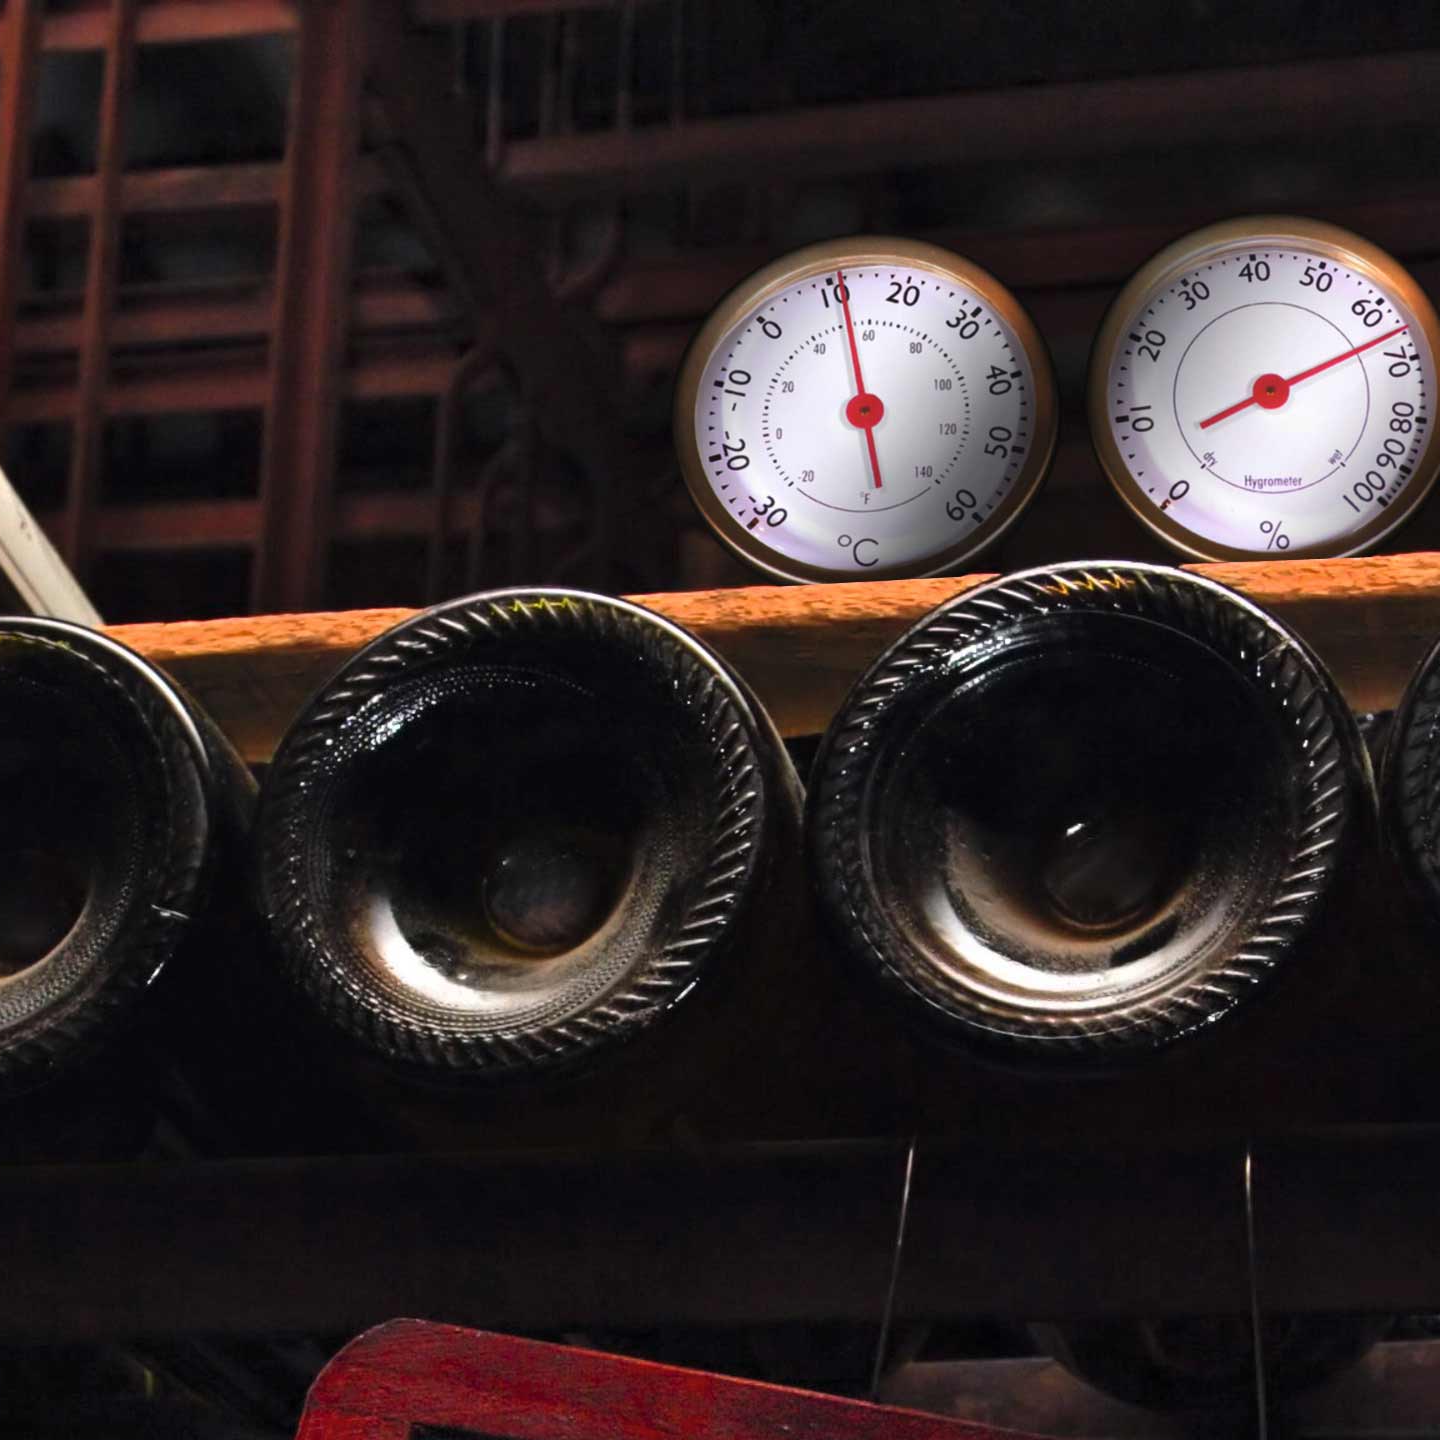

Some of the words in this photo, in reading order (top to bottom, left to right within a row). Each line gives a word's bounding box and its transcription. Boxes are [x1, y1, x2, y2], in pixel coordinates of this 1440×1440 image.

[1239, 261, 1270, 281] 40
[1299, 266, 1333, 292] 50
[821, 283, 850, 308] 10
[886, 282, 920, 306] 20
[1177, 280, 1210, 311] 30
[946, 309, 980, 340] 30
[1351, 299, 1383, 328] 60
[762, 321, 782, 339] 0
[862, 329, 875, 342] 60
[813, 343, 826, 355] 40
[909, 342, 922, 355] 80
[1138, 329, 1166, 361] 20
[1383, 346, 1410, 377] 70
[724, 369, 751, 412] -10
[781, 381, 794, 393] 20
[934, 379, 952, 391] 100
[986, 364, 1012, 395] 40
[939, 423, 957, 435] 120
[1130, 405, 1154, 431] 10
[1390, 402, 1414, 433] 80
[776, 428, 782, 440] 0
[985, 426, 1012, 459] 50
[722, 431, 750, 471] -20
[1202, 451, 1218, 467] dry
[1328, 449, 1343, 465] wet
[1376, 439, 1405, 469] 90
[798, 470, 814, 483] -20
[914, 466, 933, 478] 140
[1244, 474, 1302, 490] Hygrometer
[1169, 480, 1190, 501] 0
[1342, 470, 1386, 512] 100
[748, 495, 788, 528] -30
[946, 489, 977, 521] 60
[1260, 521, 1290, 550] %
[837, 534, 878, 567] °C
